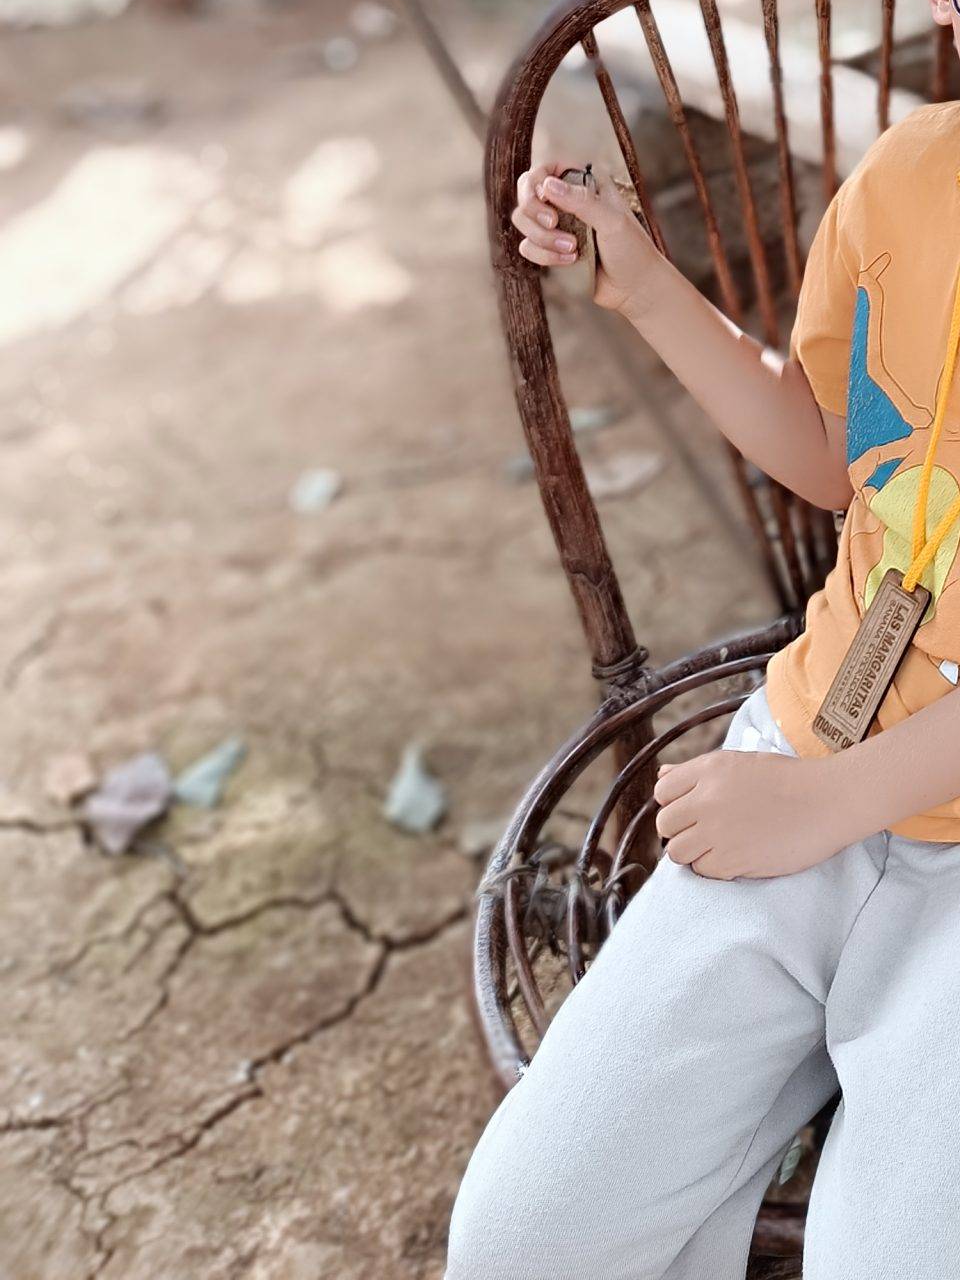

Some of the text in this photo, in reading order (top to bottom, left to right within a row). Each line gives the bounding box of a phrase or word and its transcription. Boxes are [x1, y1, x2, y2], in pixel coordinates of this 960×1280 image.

[873, 599, 897, 638] BANANA
[892, 604, 910, 631] LAS
[839, 642, 876, 711] EXPERIENCE
[848, 631, 897, 718] MARGARITAS
